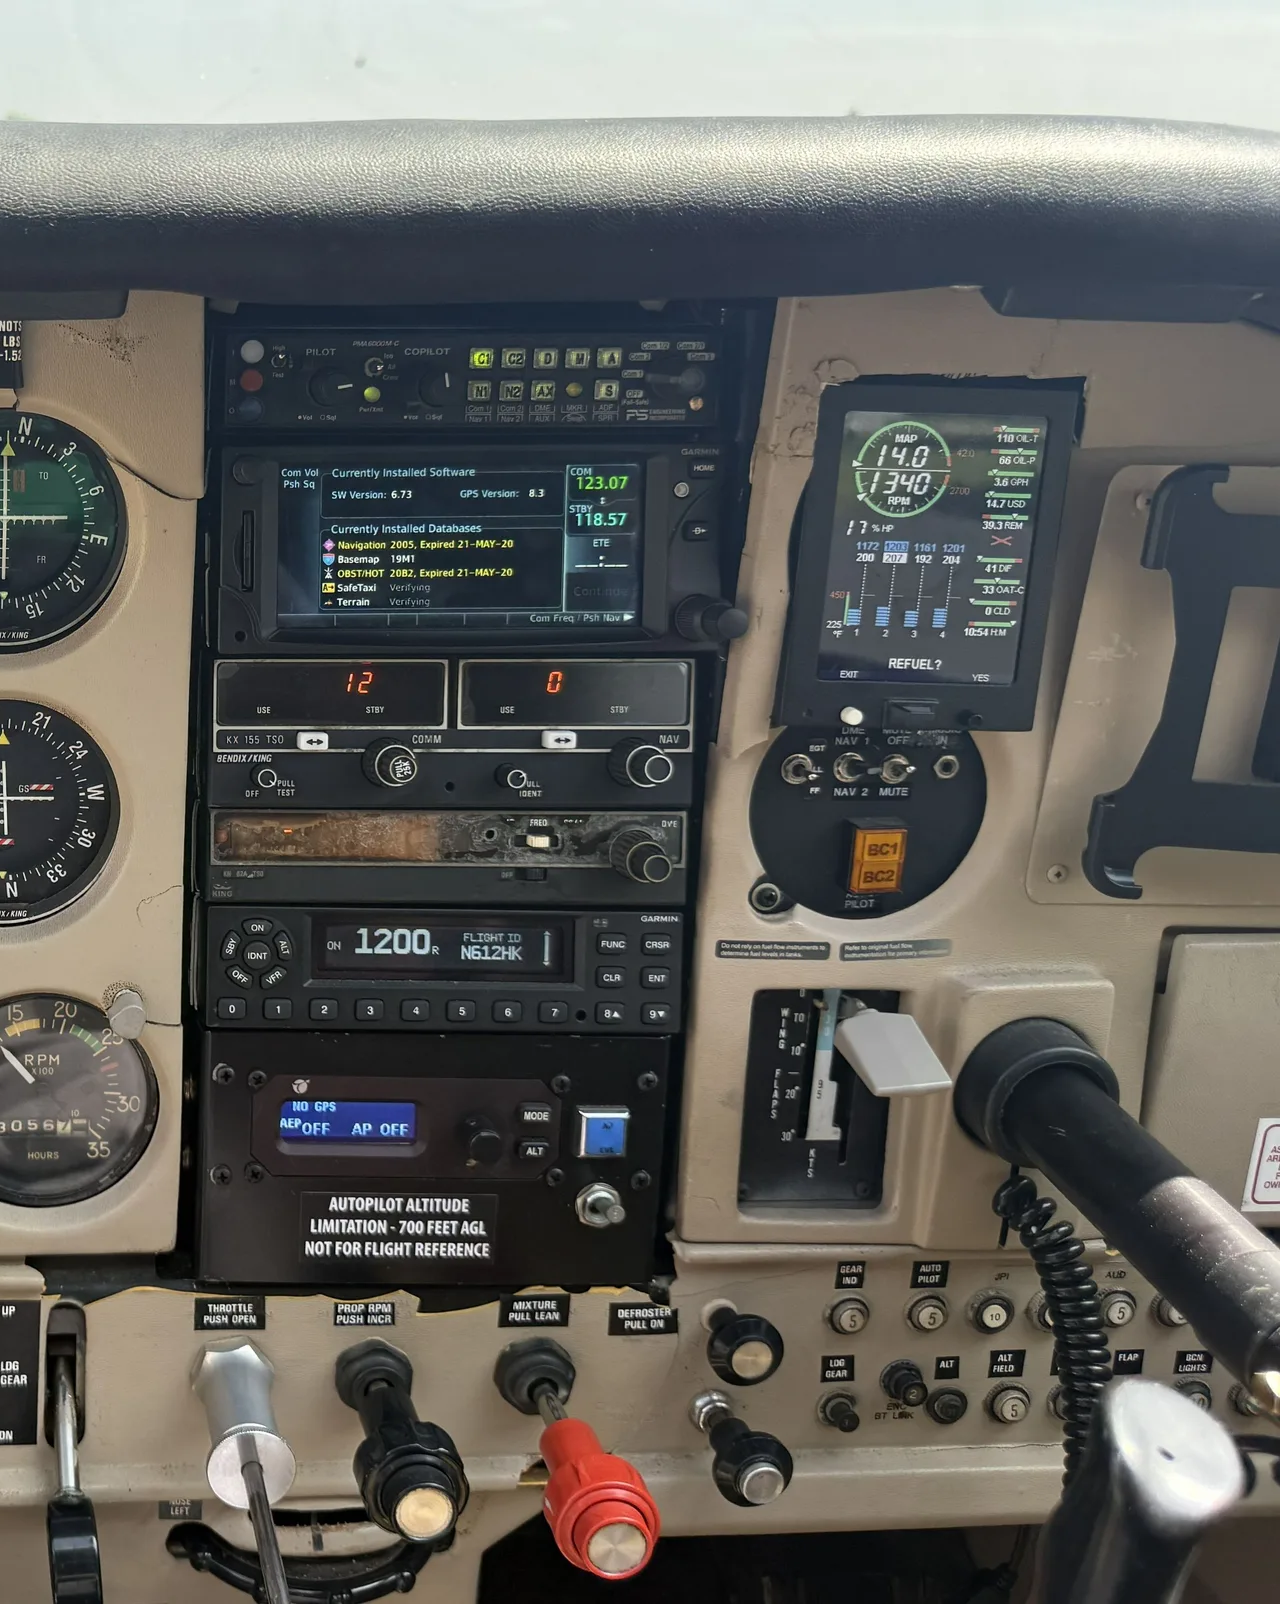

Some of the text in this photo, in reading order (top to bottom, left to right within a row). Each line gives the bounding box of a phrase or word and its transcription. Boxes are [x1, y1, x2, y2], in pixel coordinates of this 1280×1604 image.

[3, 335, 21, 347] LBS
[895, 434, 917, 444] MAP
[877, 445, 929, 467] 14.0
[332, 467, 475, 480] Currently Installed Software
[570, 468, 591, 476] COM
[577, 477, 627, 490] 123.07
[870, 473, 931, 493] 1340
[994, 478, 1028, 486] 3.6 GPH
[332, 490, 412, 499] SW Version: 6.73
[460, 488, 544, 498] GPS Version: 8.3
[888, 496, 910, 505] RPM
[569, 505, 592, 513] STBY
[576, 513, 626, 526] 118.57
[331, 523, 481, 536] Currently Installed Databases
[338, 540, 513, 551] Navigation 2005, Expired 21-MAY-20
[337, 568, 512, 579] OBST/HOT 20B2, Expired 21-MAY-20
[337, 582, 430, 594] SafeTaxi Verifying
[337, 597, 430, 608] Terrain Verifying
[888, 658, 941, 671] REFUEL?
[840, 670, 858, 679] EXIT
[972, 674, 989, 682] YES
[257, 706, 270, 714] USE
[365, 706, 384, 714] STBY
[412, 735, 441, 744] COMM
[659, 735, 680, 744] NAV
[217, 754, 272, 764] BENDIX/KING
[867, 843, 898, 856] BC1
[863, 870, 894, 883] BC2
[355, 928, 430, 954] 1200
[463, 933, 521, 942] FLIGHT ID
[601, 940, 625, 949] FUNC
[646, 940, 670, 949] CRSR
[460, 946, 522, 961] N612HK
[25, 1054, 60, 1065] RPM
[293, 1101, 336, 1112] NO GPS
[524, 1110, 548, 1122] MODE
[280, 1118, 409, 1135] AEP OFF AP OFF
[527, 1146, 543, 1157] ALT
[329, 1197, 470, 1214] AUTOPILOT ALTITUDE
[310, 1219, 486, 1237] LIMITATION 700 FEET AGL
[305, 1241, 490, 1258] NOT FOR FLIGHT REFERENCE
[840, 1264, 862, 1274] GEAR
[920, 1263, 941, 1273] AUTO
[843, 1275, 857, 1286] IND
[918, 1274, 940, 1284] PILOT
[208, 1303, 253, 1314] THROTTLE
[338, 1303, 391, 1314] PROP RPM
[513, 1300, 557, 1311] MIXTURE
[204, 1314, 257, 1324] PUSH OPEN
[336, 1314, 392, 1325] PUSH INCR
[508, 1310, 560, 1321] PULL LEAN
[0, 1361, 19, 1371] LDG
[0, 1375, 27, 1385] GEAR
